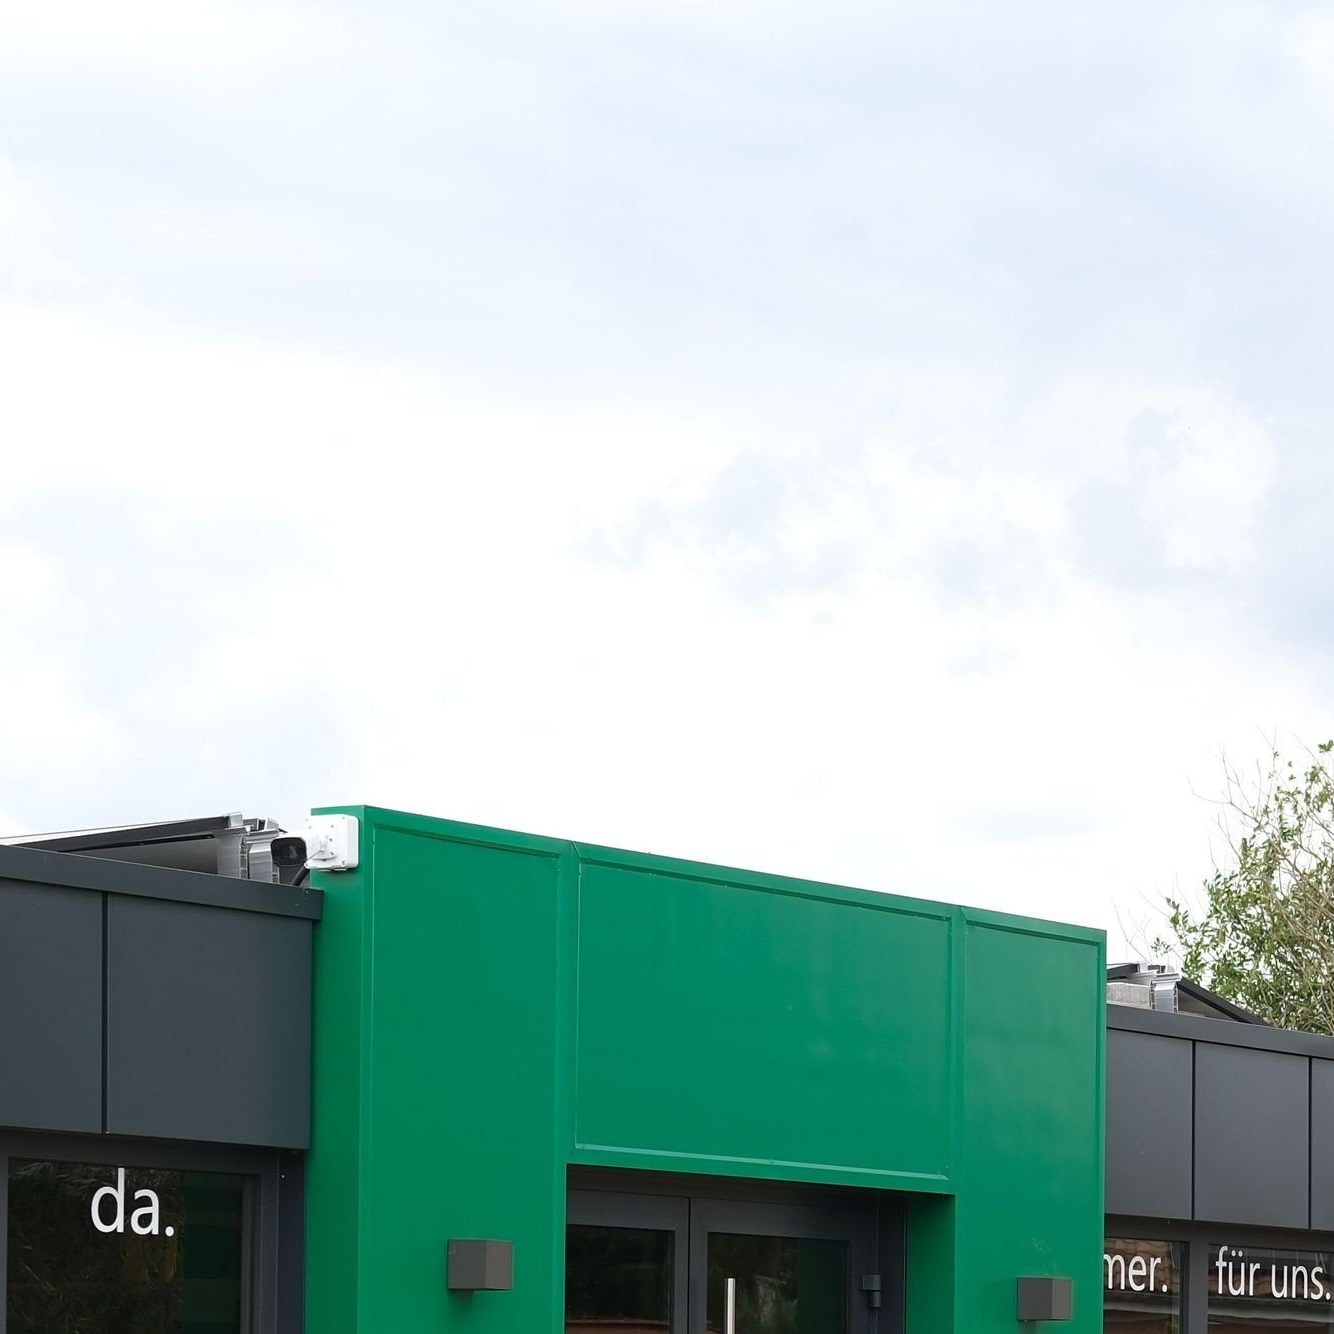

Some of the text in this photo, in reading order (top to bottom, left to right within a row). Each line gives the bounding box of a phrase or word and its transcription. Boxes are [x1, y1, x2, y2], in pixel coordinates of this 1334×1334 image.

[91, 1167, 175, 1237] da.
[1215, 1246, 1260, 1297] für
[1271, 1263, 1331, 1300] uns.
